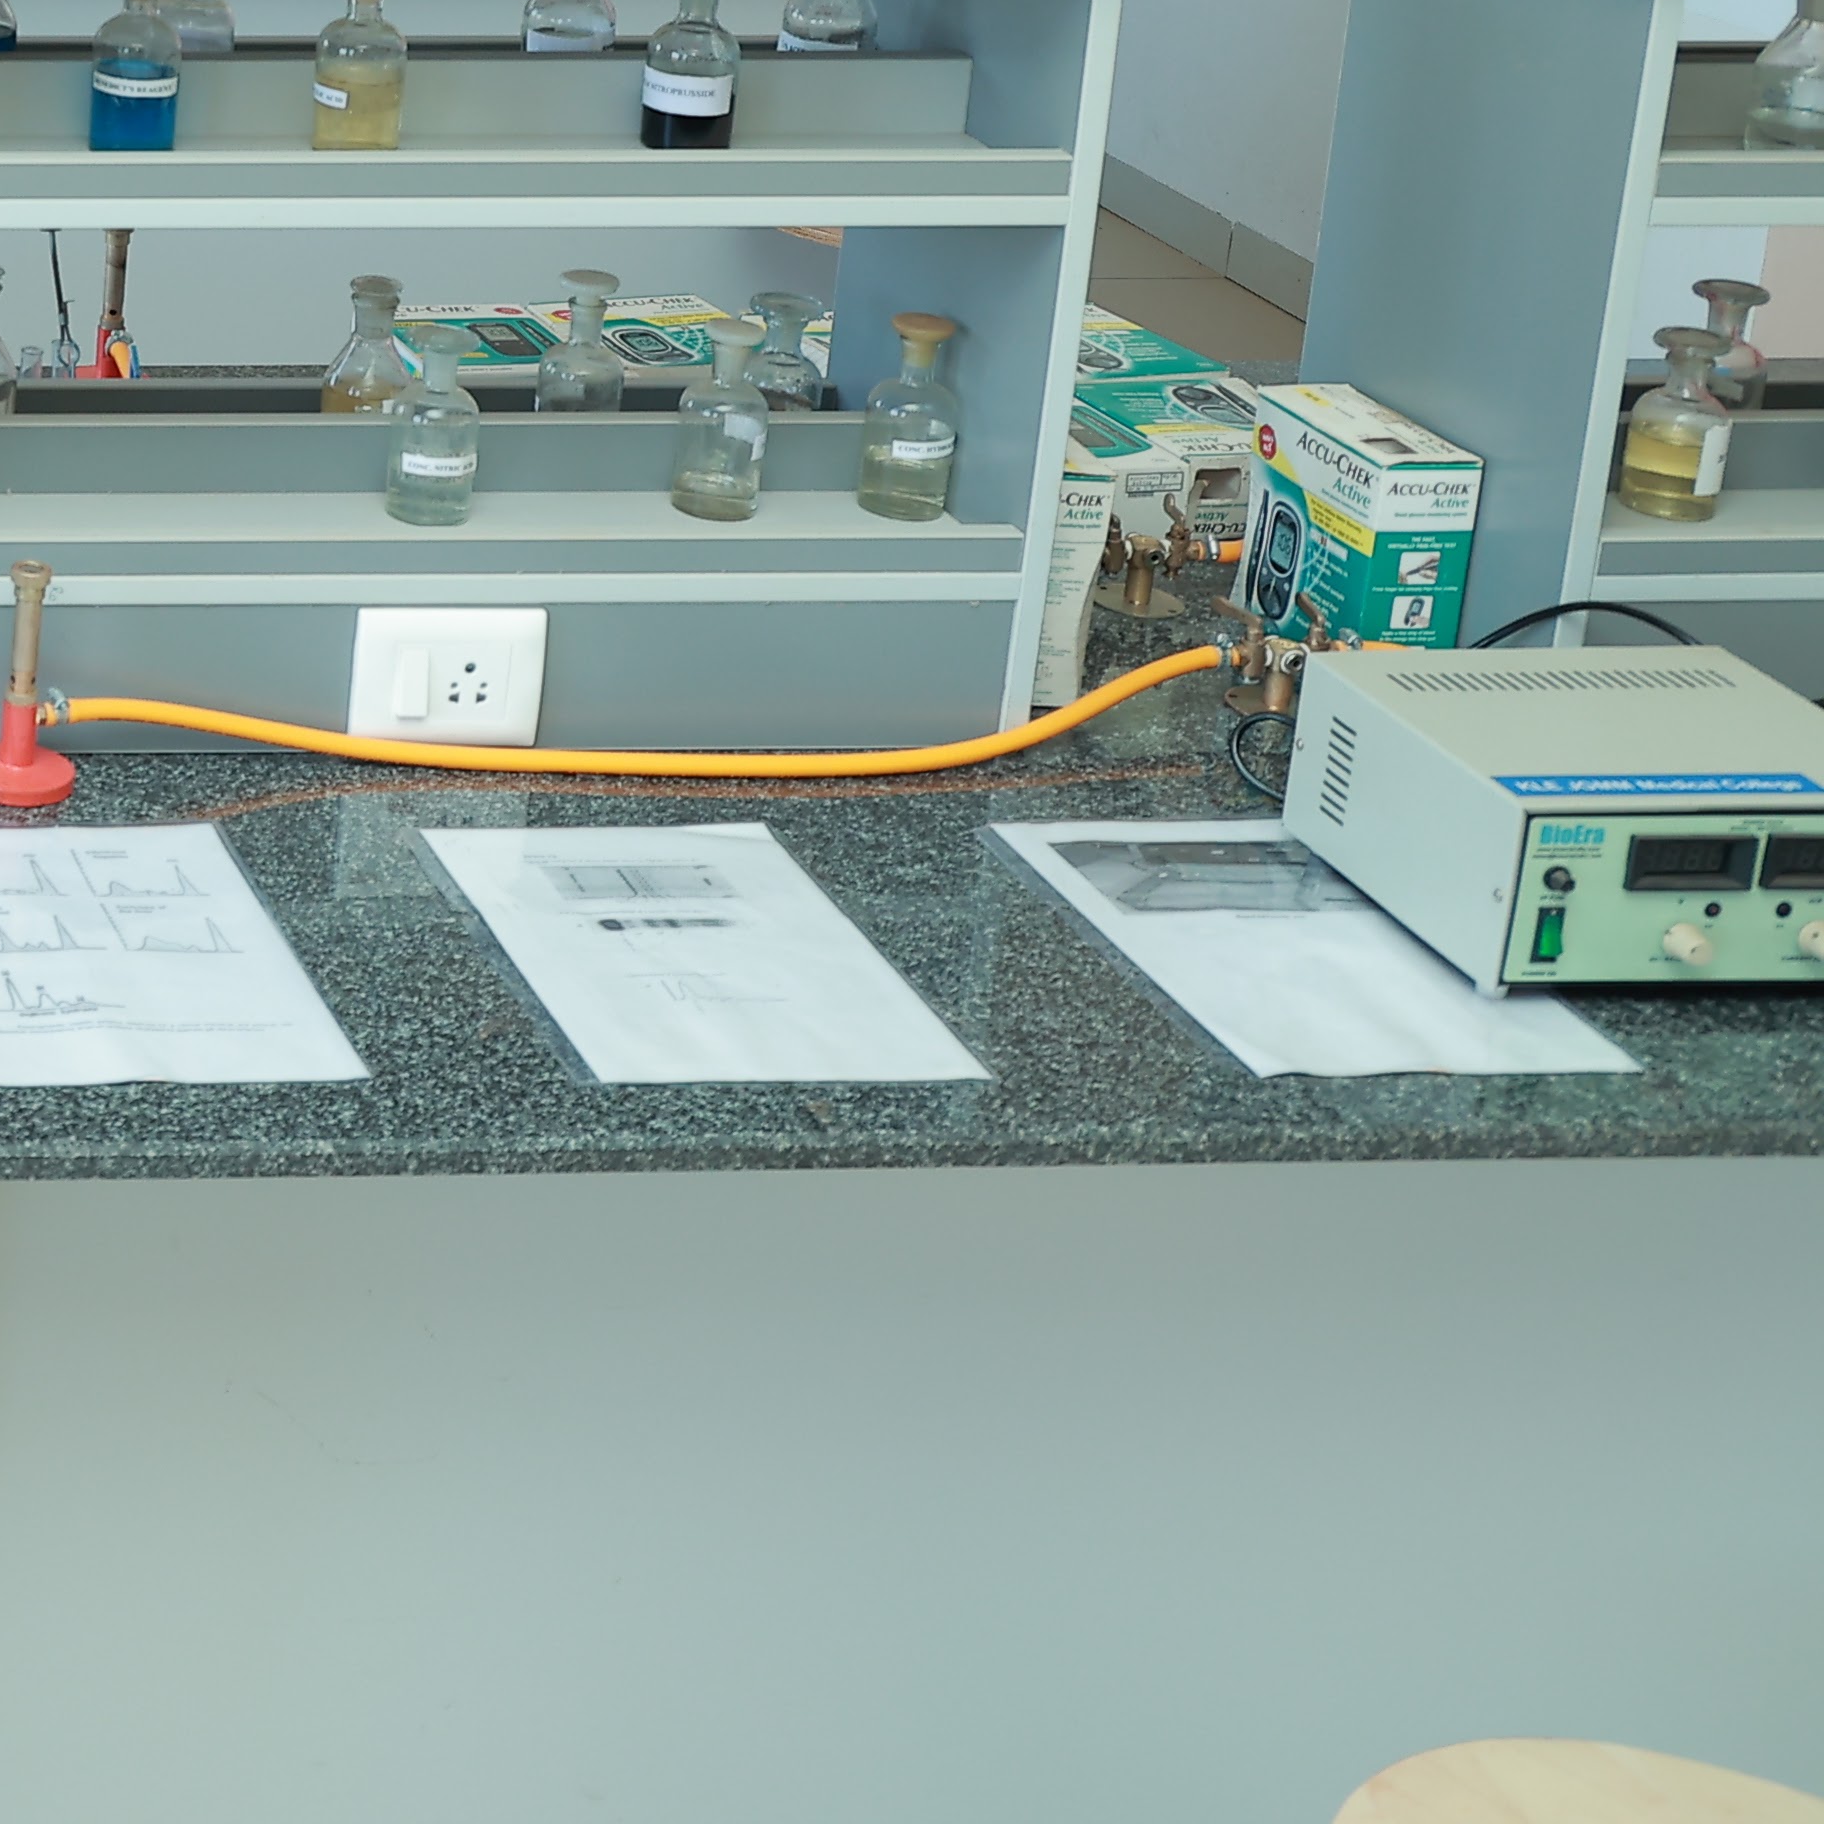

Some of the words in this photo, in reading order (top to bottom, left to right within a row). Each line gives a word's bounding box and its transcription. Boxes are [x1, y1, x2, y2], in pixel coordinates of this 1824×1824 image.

[1296, 431, 1378, 489] ACCU-CHEK
[1332, 477, 1372, 509] Active
[1387, 481, 1470, 497] ACCU-CHEK
[1431, 498, 1470, 509] Active
[1064, 508, 1104, 521] Active
[1515, 779, 1564, 792] KLE
[1636, 779, 1721, 792] Medical
[1721, 778, 1802, 792] College
[1540, 825, 1605, 845] BioEra
